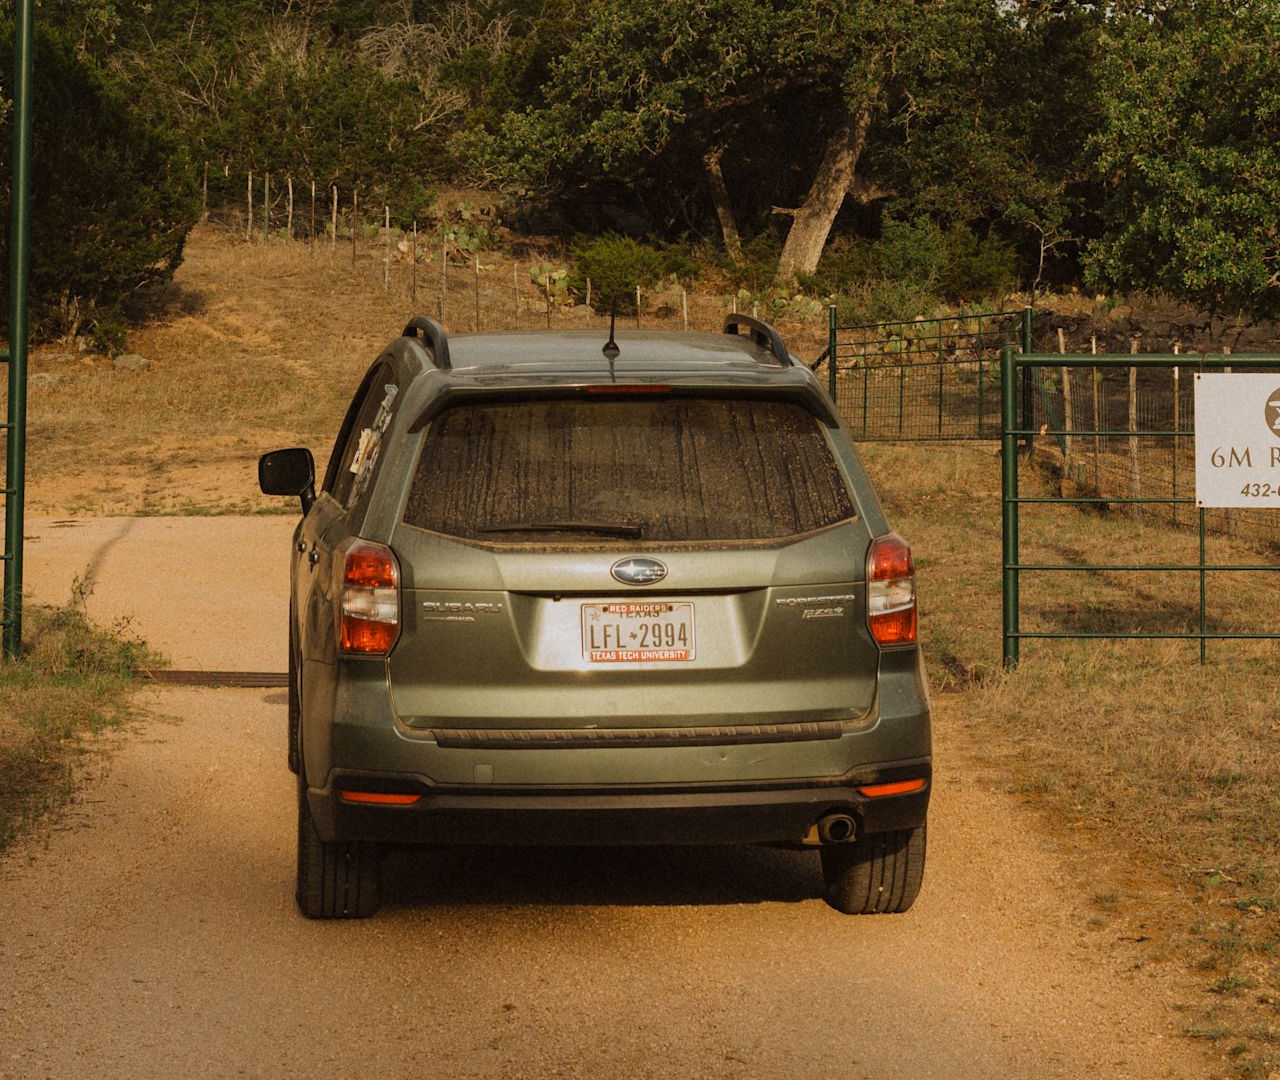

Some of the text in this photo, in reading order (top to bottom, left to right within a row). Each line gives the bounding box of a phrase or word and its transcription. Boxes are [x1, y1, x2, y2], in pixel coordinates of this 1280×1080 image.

[1210, 446, 1253, 468] 6M
[776, 595, 856, 608] FORESTER
[423, 602, 502, 614] SUBARU
[609, 603, 667, 613] RED RAIDERS
[592, 650, 686, 660] TEXAS TECH UNIVERSITY
